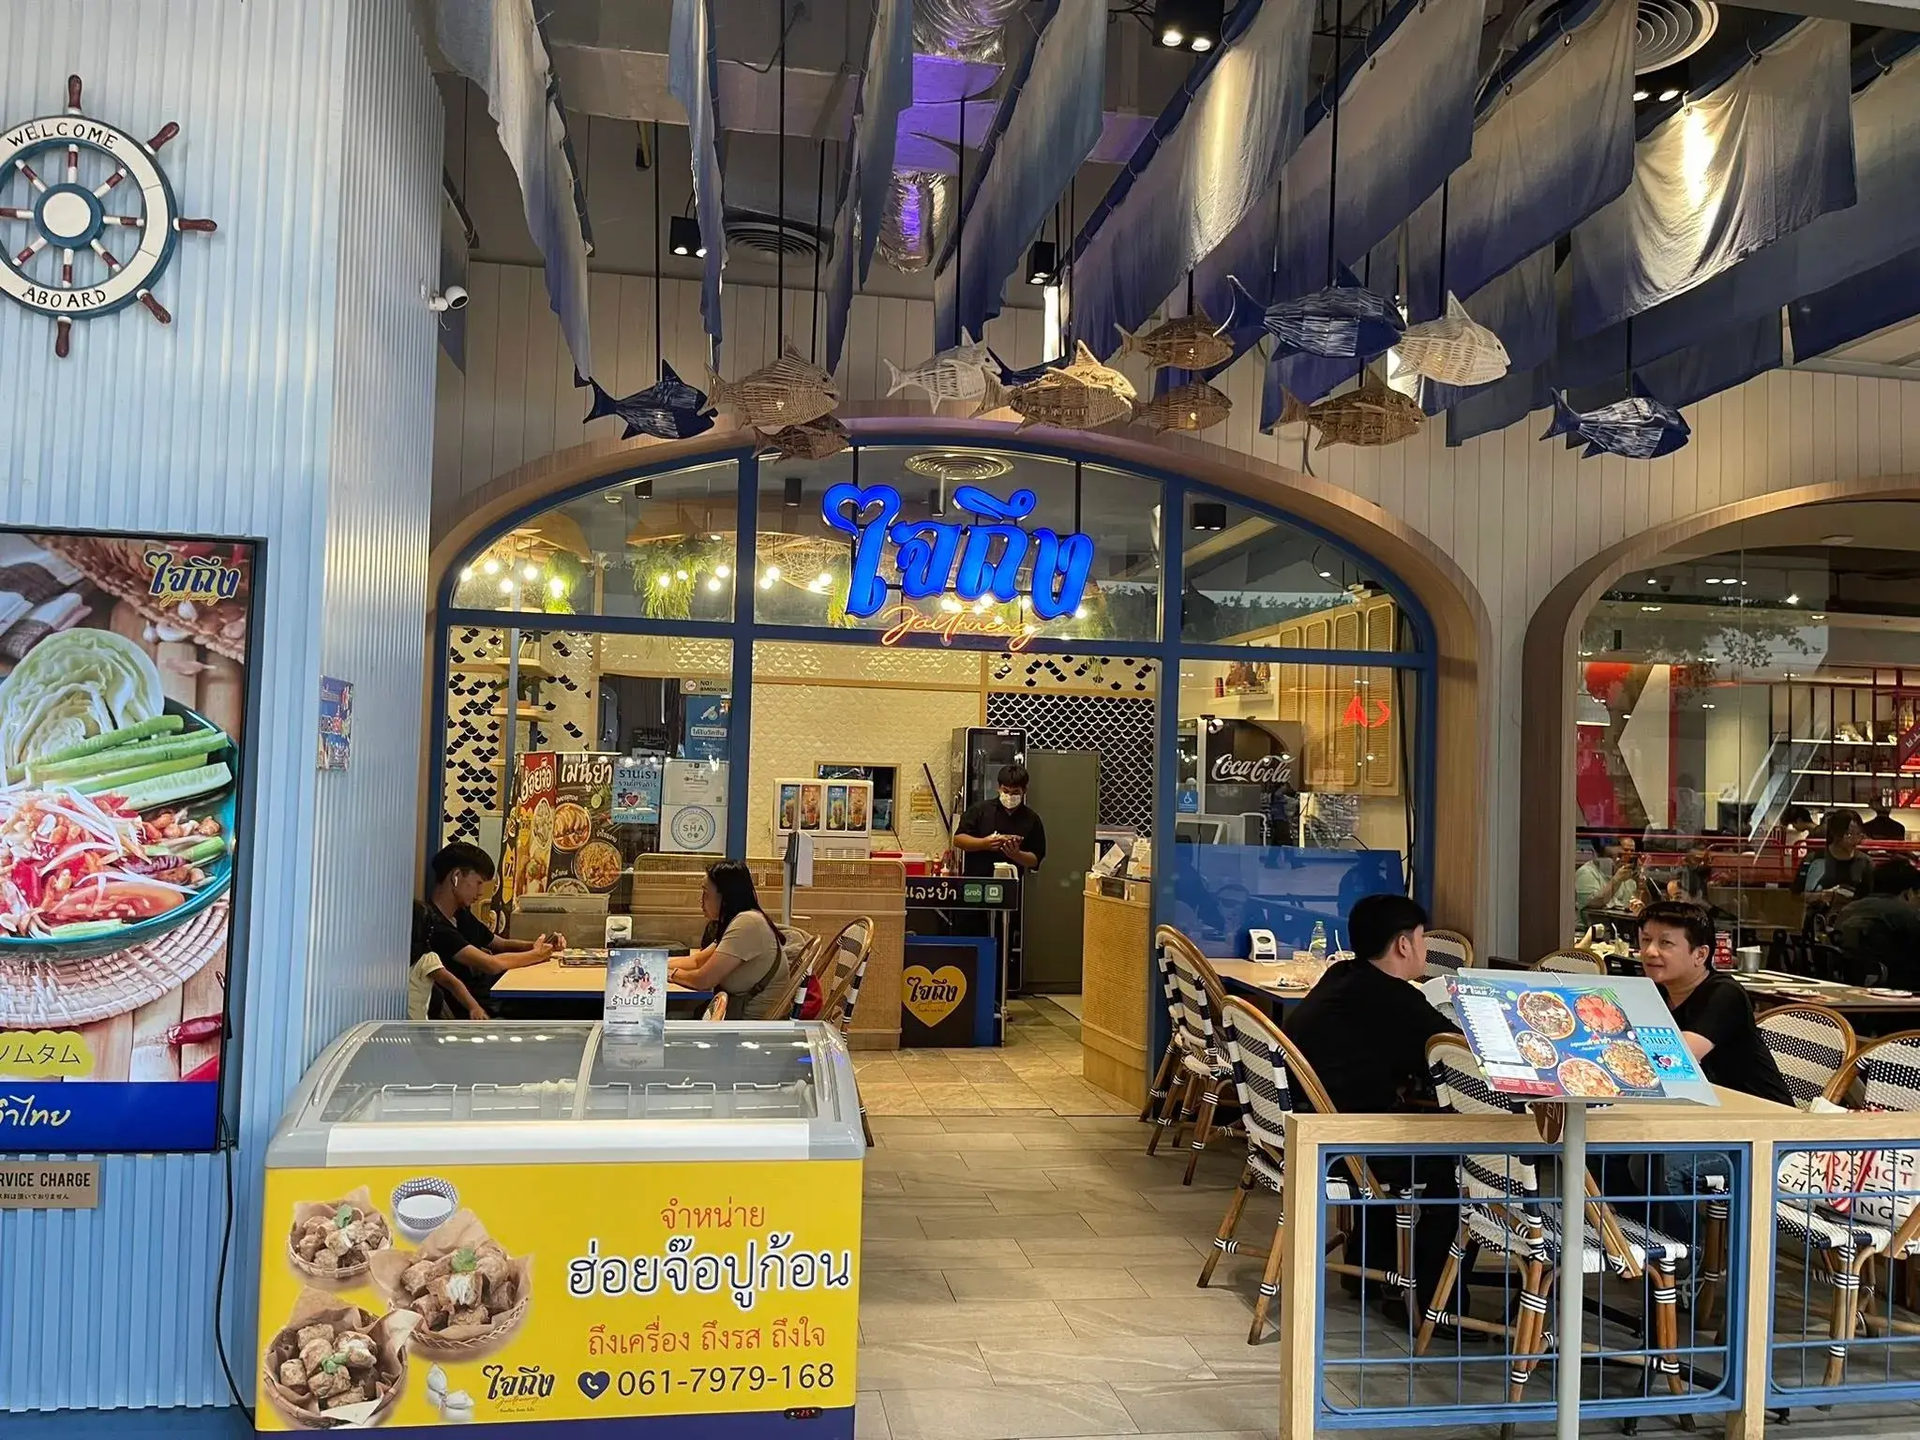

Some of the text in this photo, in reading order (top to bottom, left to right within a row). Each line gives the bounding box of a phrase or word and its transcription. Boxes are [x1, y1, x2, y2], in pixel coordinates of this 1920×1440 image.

[7, 122, 119, 150] WELCOME
[22, 286, 107, 309] ABOARD
[821, 482, 1095, 620] ใจถึง
[144, 551, 241, 598] ใจถึง
[1211, 752, 1296, 783] Coca-Cola
[683, 825, 704, 833] SHA
[964, 889, 982, 897] Grab
[906, 977, 958, 1003] ใจถึง
[40, 1172, 91, 1188] CHARGE
[660, 1196, 766, 1230] จำหน่าย
[568, 1233, 850, 1310] ฮ่อยจ๊อปูก้อน
[588, 1315, 826, 1355] ถึงเครื่อง ถึงรส ถึงใจ
[482, 1364, 556, 1400] ใจถึง
[617, 1363, 835, 1396] 061-7979-168
